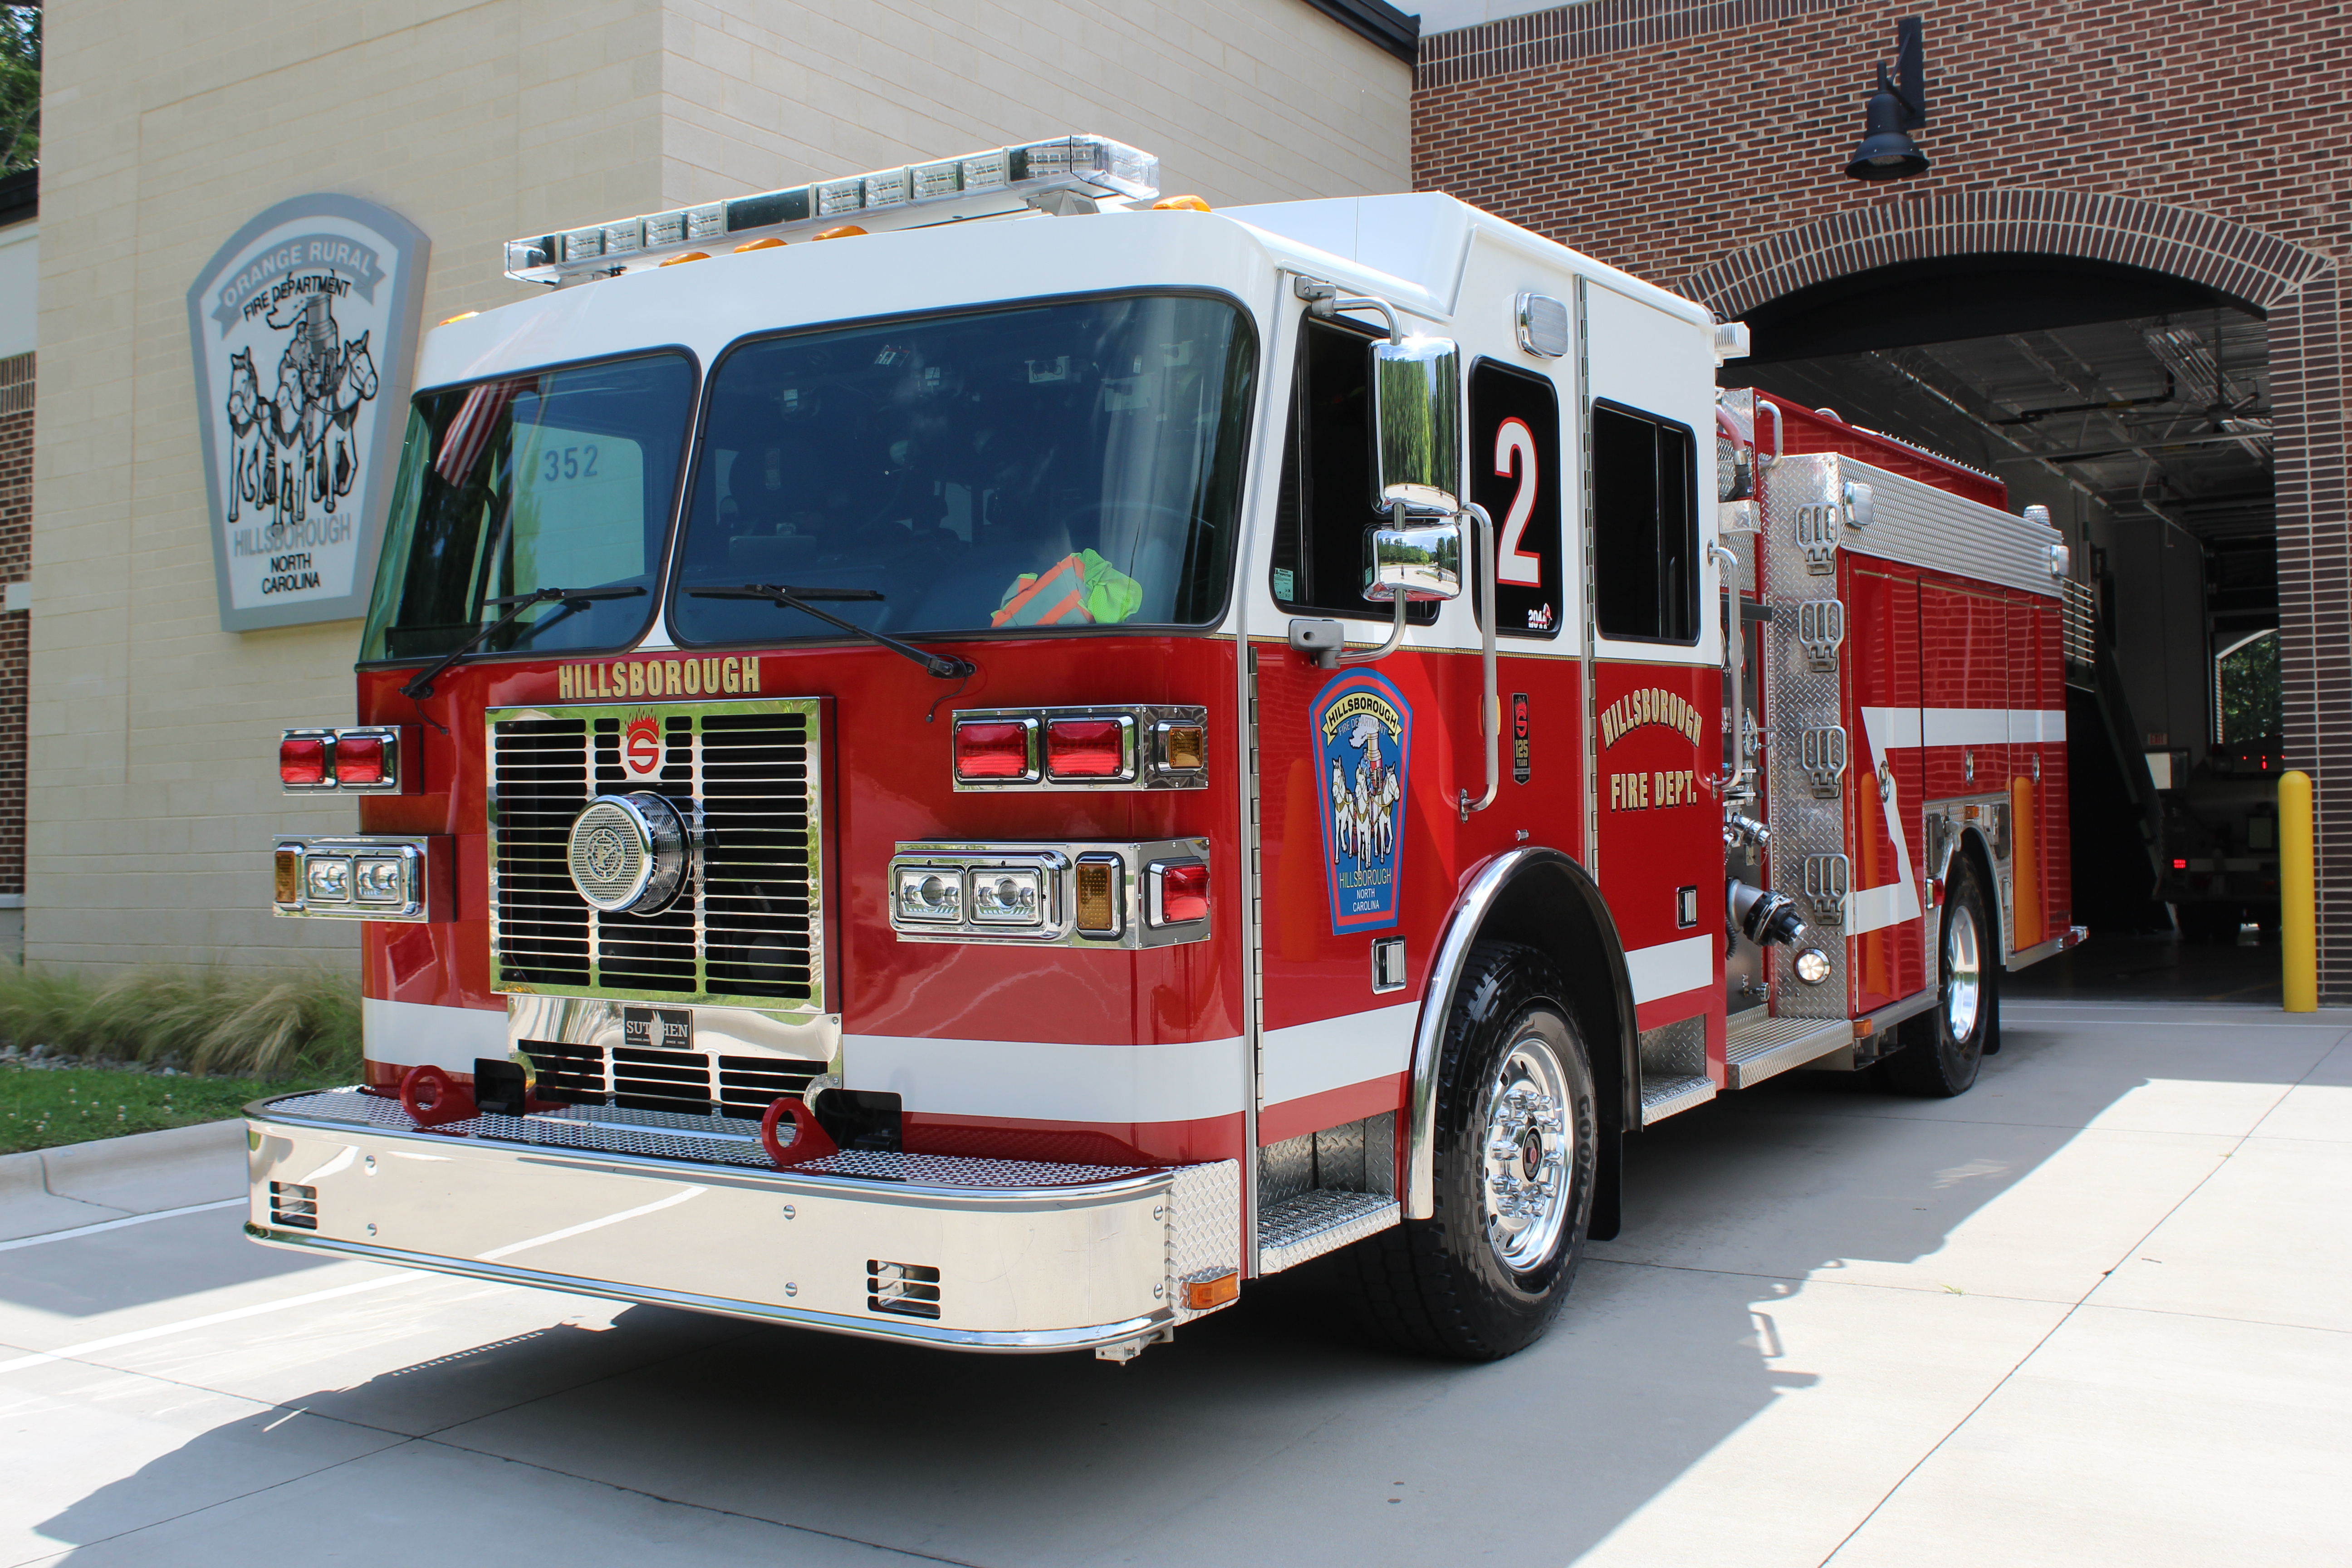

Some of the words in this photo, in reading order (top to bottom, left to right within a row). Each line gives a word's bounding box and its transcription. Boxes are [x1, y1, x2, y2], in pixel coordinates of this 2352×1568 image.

[224, 244, 302, 307] ORANGE
[309, 241, 371, 277] RURAL
[243, 290, 270, 322] FIRE
[272, 275, 351, 301] DEPARTMENT
[544, 445, 598, 481] 352
[1494, 416, 1541, 588] 2
[234, 513, 351, 557] HILLSBOROUGH
[271, 552, 312, 573] NORTH
[262, 572, 321, 594] CAROLINA
[558, 657, 760, 700] HILLSBOROUGH
[1328, 697, 1396, 728] HILLSBOROUGH
[1338, 720, 1351, 736] FIRE
[1351, 717, 1387, 735] DEPARTMENT
[1601, 688, 1703, 751] HILLSBOROUGH
[1515, 740, 1529, 758] 125
[1611, 773, 1648, 813] FIRE
[1654, 770, 1697, 809] DEPT.
[1340, 868, 1391, 888] HILLSBOROUGH
[1357, 888, 1375, 899] NORTH
[1353, 900, 1379, 912] CAROLINA
[626, 1020, 688, 1037] SUTPHEN
